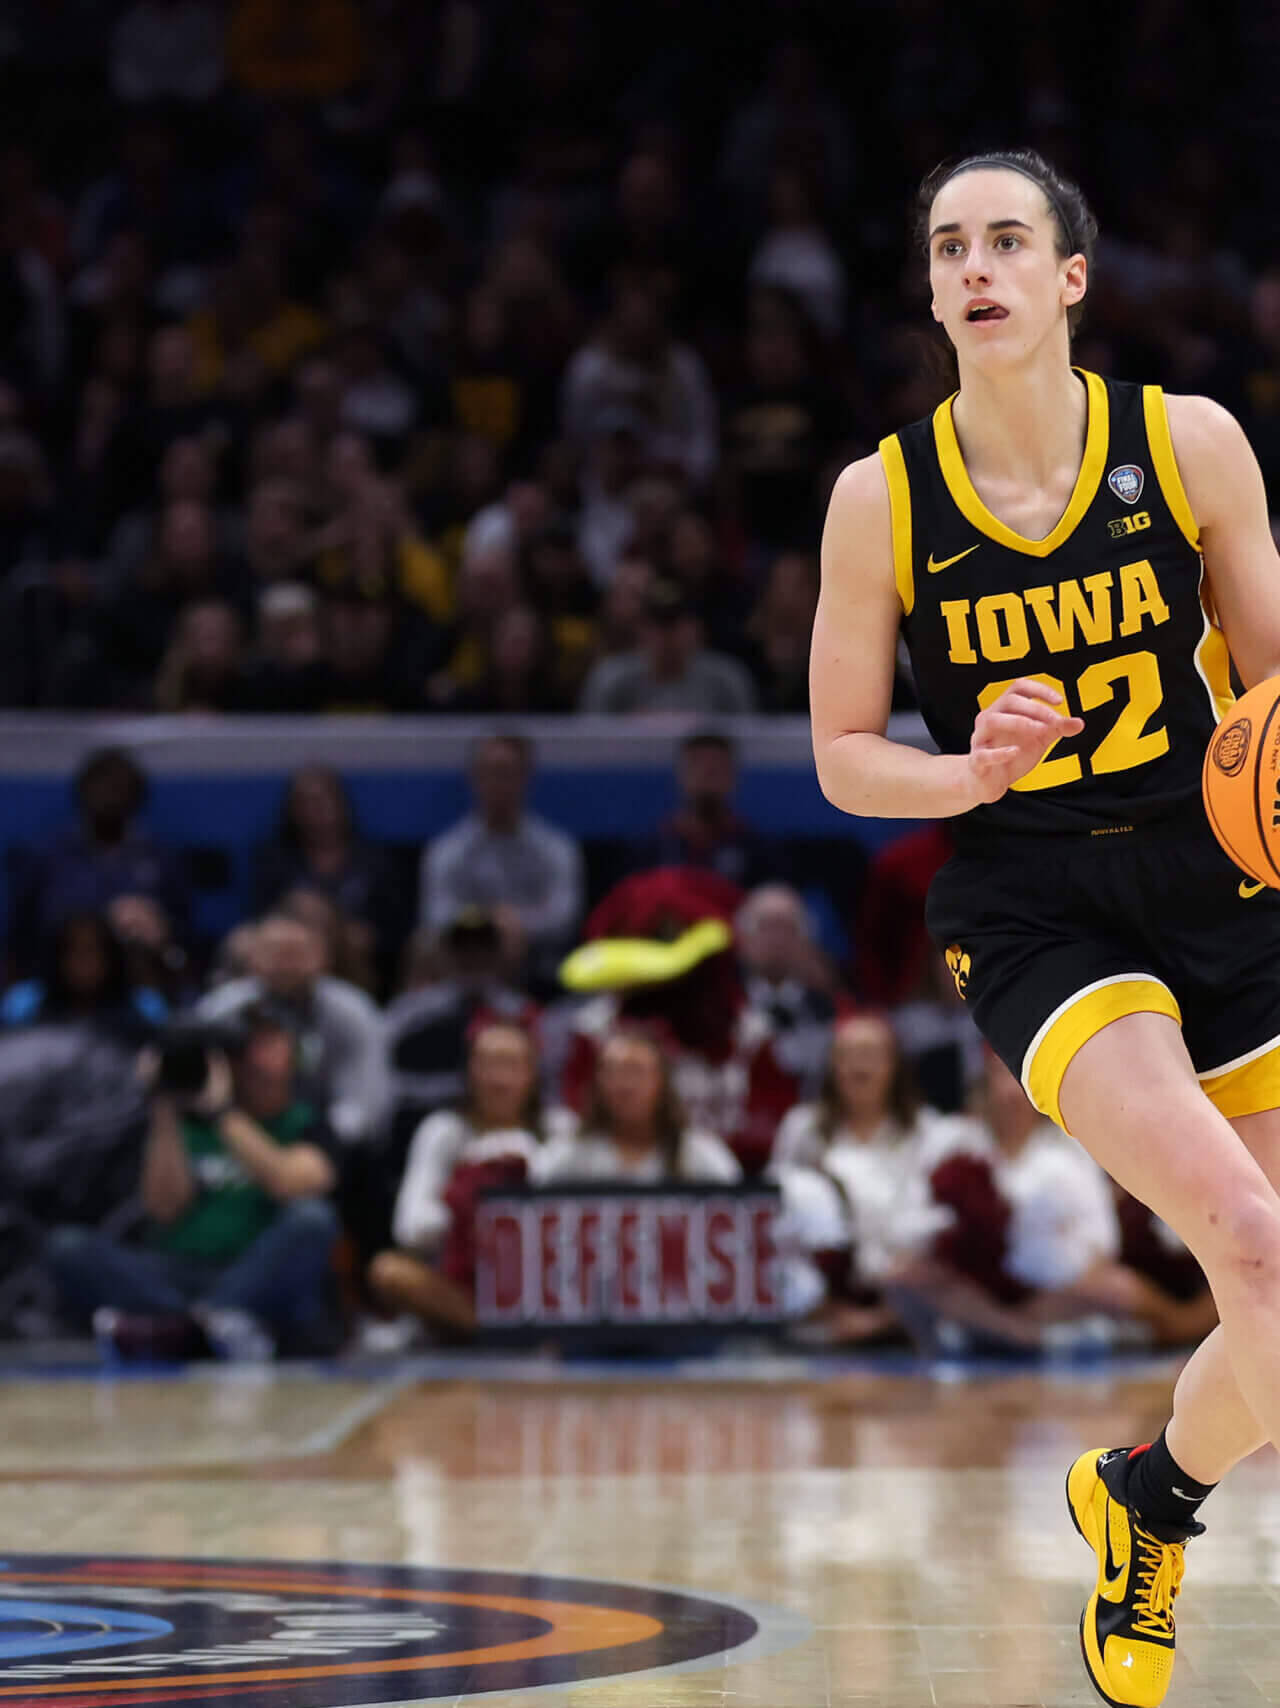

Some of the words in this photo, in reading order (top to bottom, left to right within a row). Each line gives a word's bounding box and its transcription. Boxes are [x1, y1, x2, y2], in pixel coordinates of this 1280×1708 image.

[941, 559, 1170, 664] IOWA
[977, 650, 1170, 792] 22
[484, 1203, 785, 1316] DEFENSE
